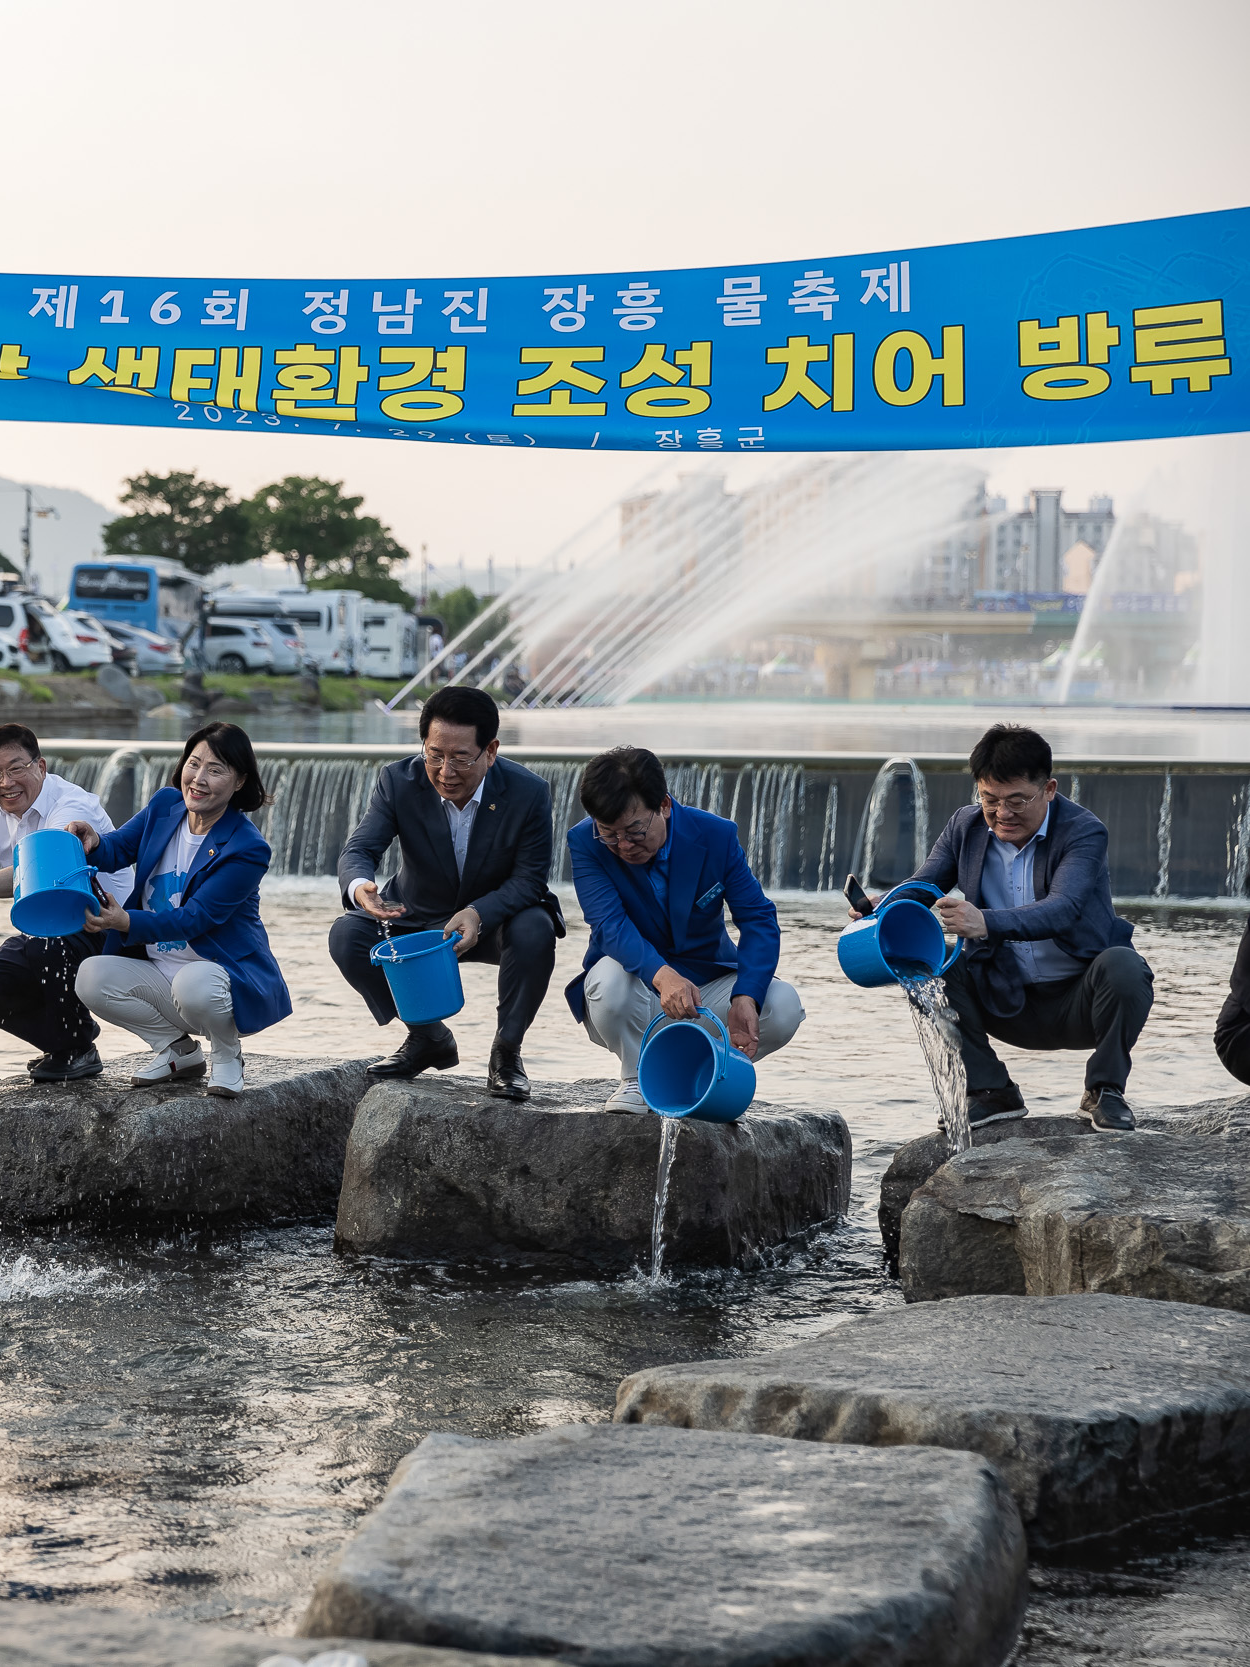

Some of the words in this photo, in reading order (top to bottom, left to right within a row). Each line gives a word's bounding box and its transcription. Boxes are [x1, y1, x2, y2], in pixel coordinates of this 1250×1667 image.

[29, 285, 250, 331] 제16회
[302, 288, 489, 335] 정남진
[542, 281, 664, 333] 장흥
[716, 260, 911, 327] 물축제
[68, 343, 468, 422] 생태환경
[512, 341, 713, 418] 조성
[763, 324, 965, 413] 치어
[1018, 299, 1232, 401] 방류
[655, 426, 765, 449] 장흥군
